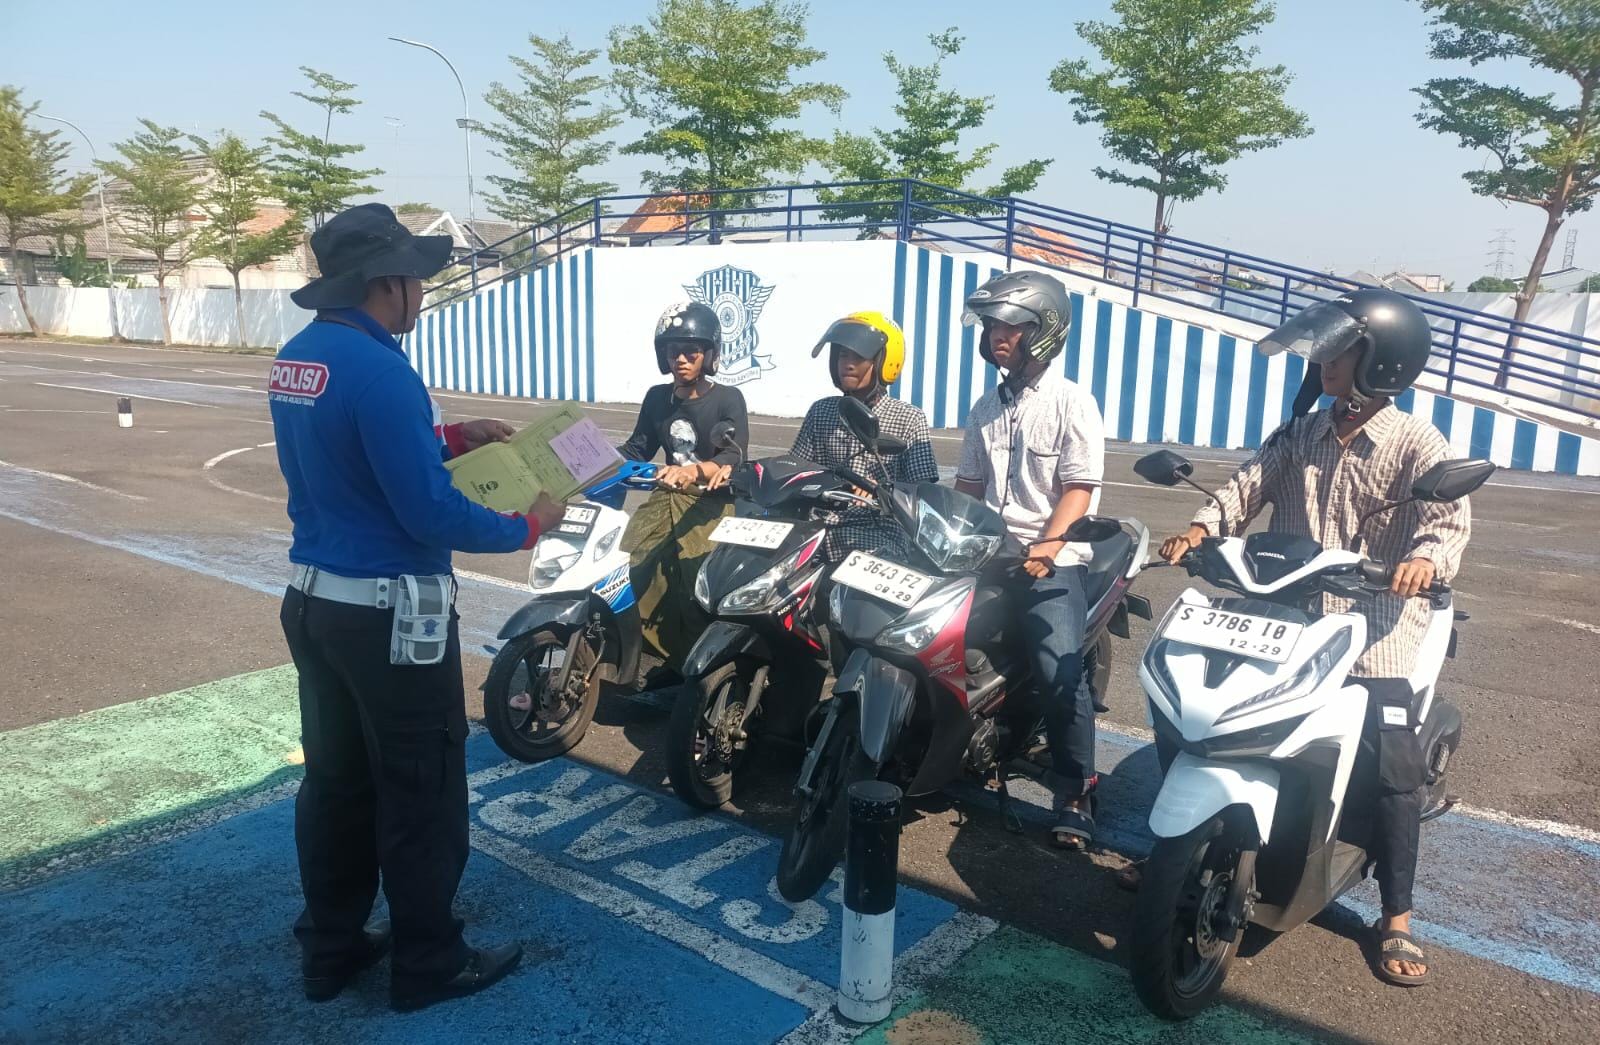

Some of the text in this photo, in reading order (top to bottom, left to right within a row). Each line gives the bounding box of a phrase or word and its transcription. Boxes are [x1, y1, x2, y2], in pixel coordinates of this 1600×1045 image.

[270, 365, 322, 392] POLISI
[848, 555, 922, 590] S 3643 FZ
[599, 576, 629, 596] SUZUKI
[1180, 607, 1195, 621] S
[1203, 612, 1252, 633] 3786
